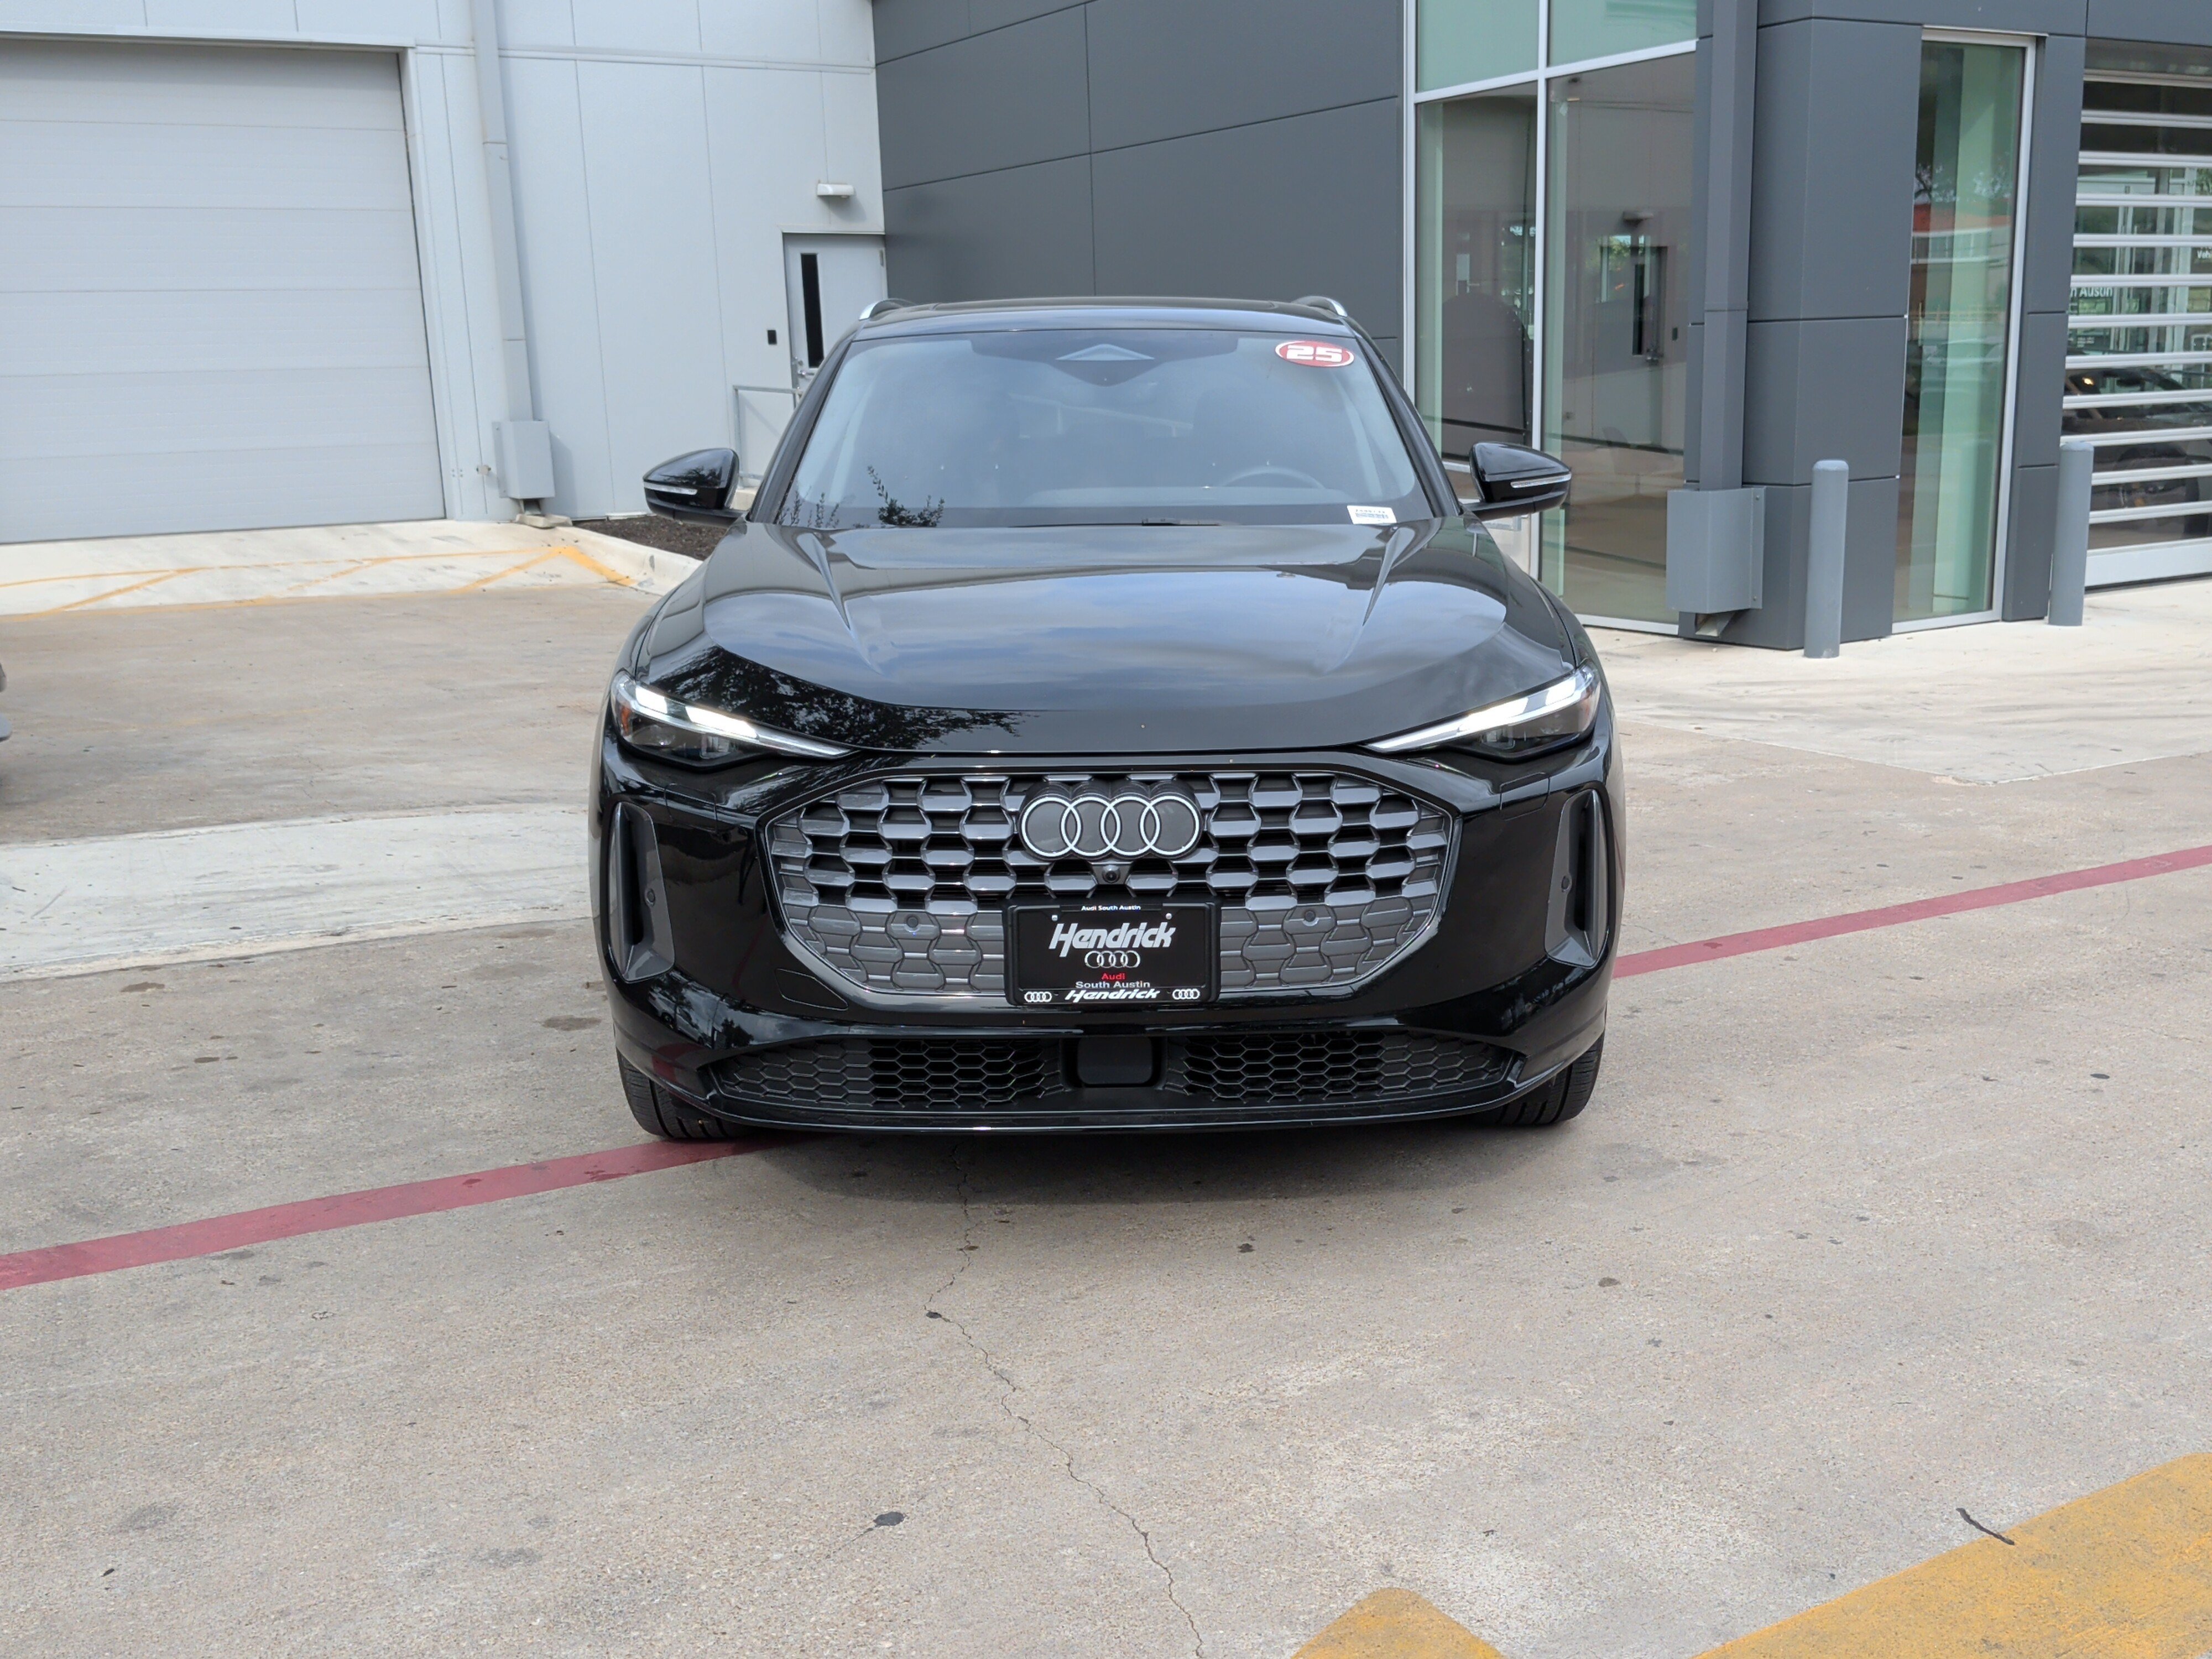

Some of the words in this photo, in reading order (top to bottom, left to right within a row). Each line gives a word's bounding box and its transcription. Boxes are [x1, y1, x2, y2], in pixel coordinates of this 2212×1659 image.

[1286, 345, 1343, 362] 25
[1048, 922, 1176, 957] Hendrick
[1113, 980, 1151, 988] Austin
[1065, 989, 1161, 1003] Hendrick
